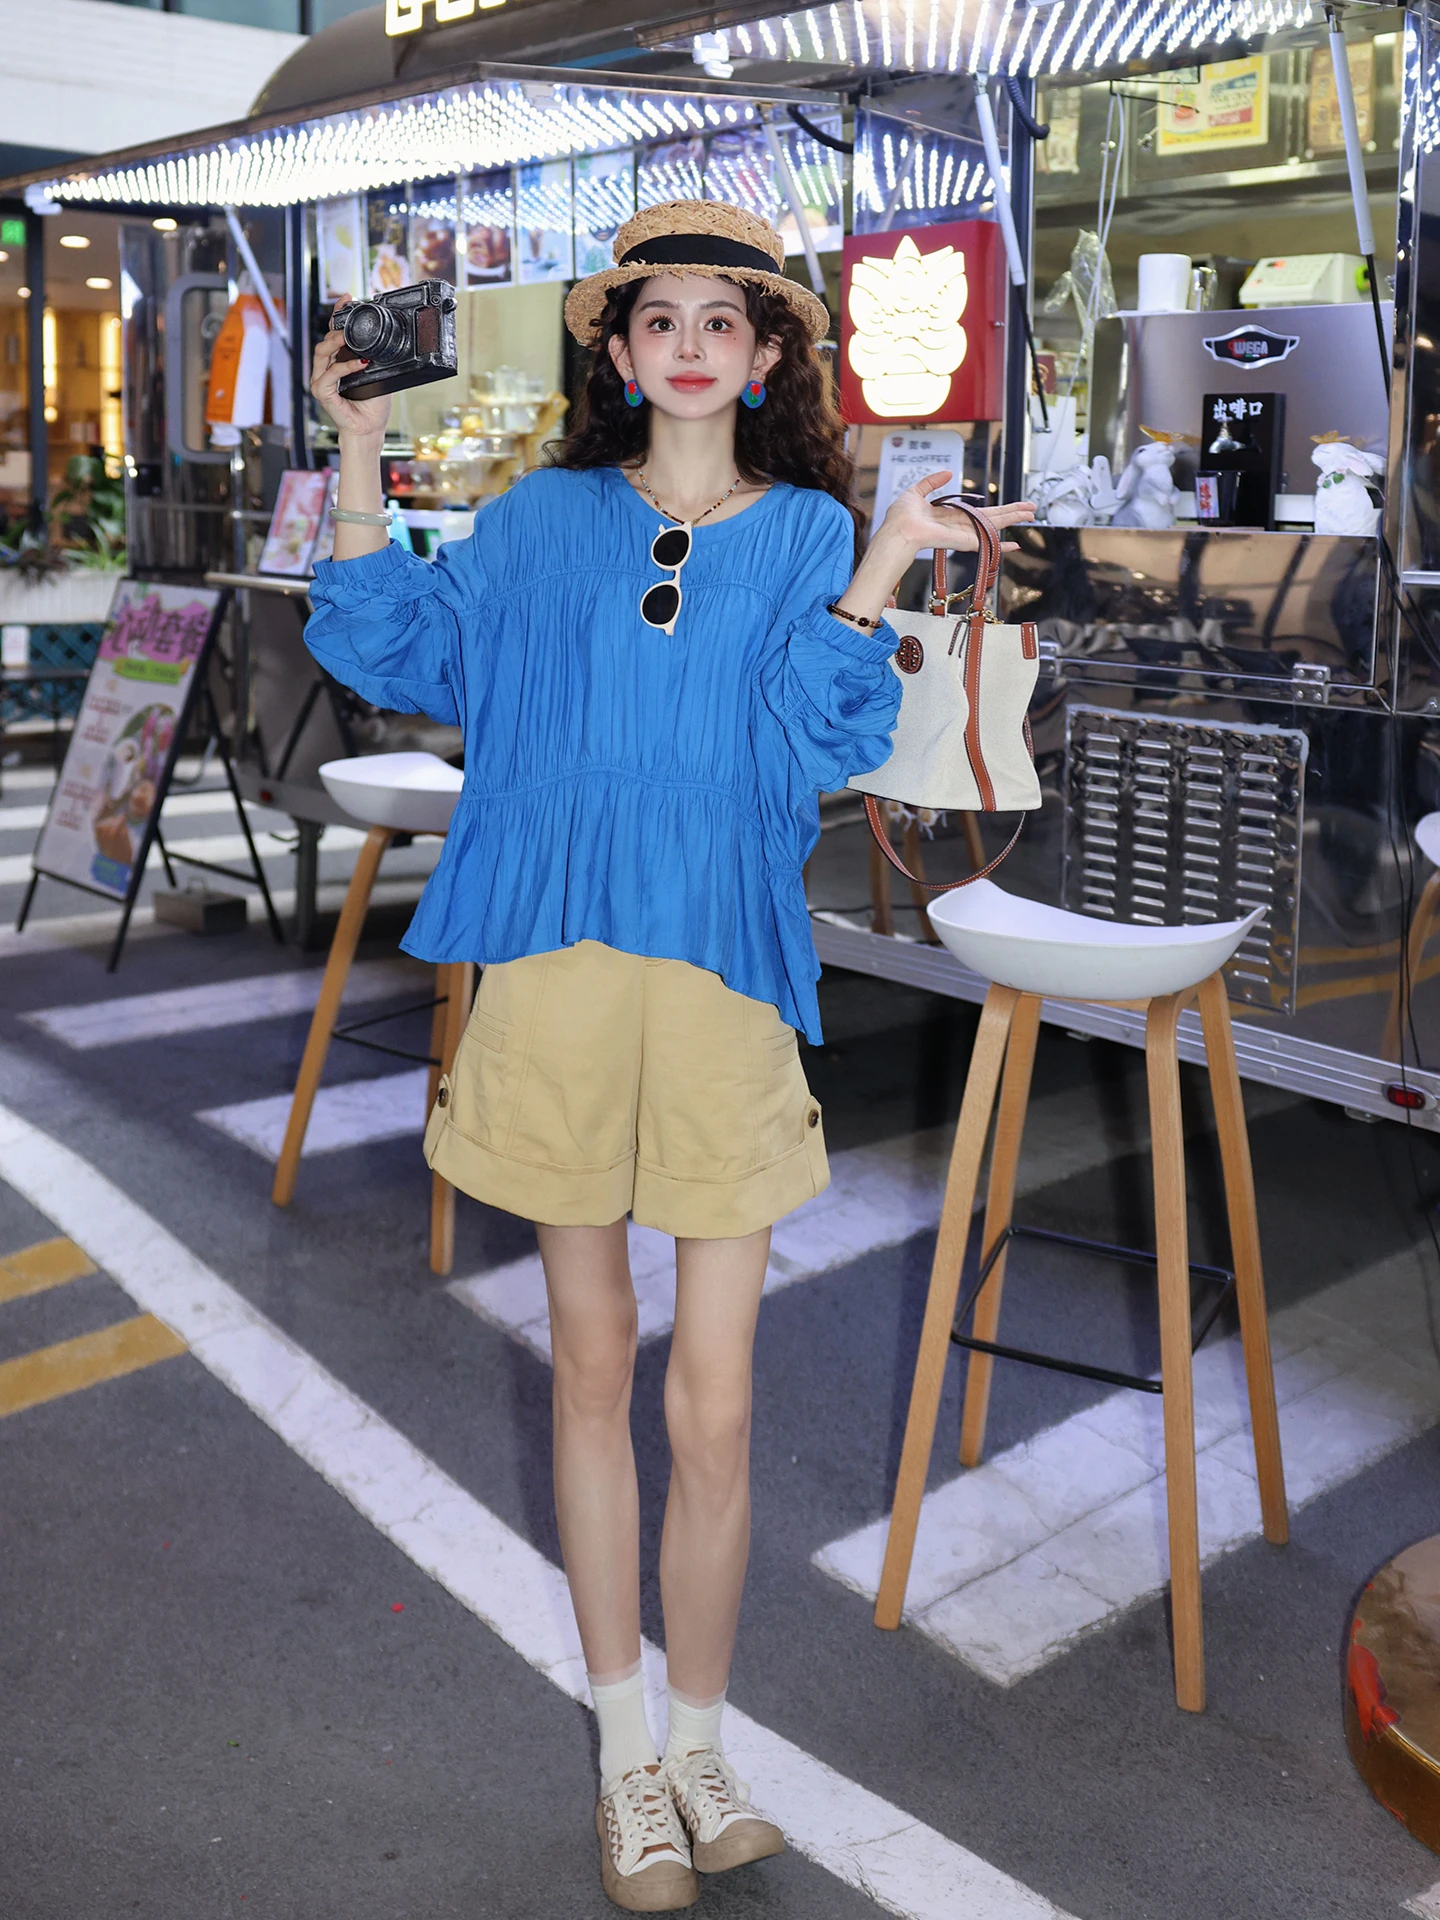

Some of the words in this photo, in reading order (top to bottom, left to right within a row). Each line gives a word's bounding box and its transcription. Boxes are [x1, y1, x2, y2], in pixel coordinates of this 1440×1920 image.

[1233, 340, 1268, 355] WEGA
[1213, 397, 1263, 422] 出啡口
